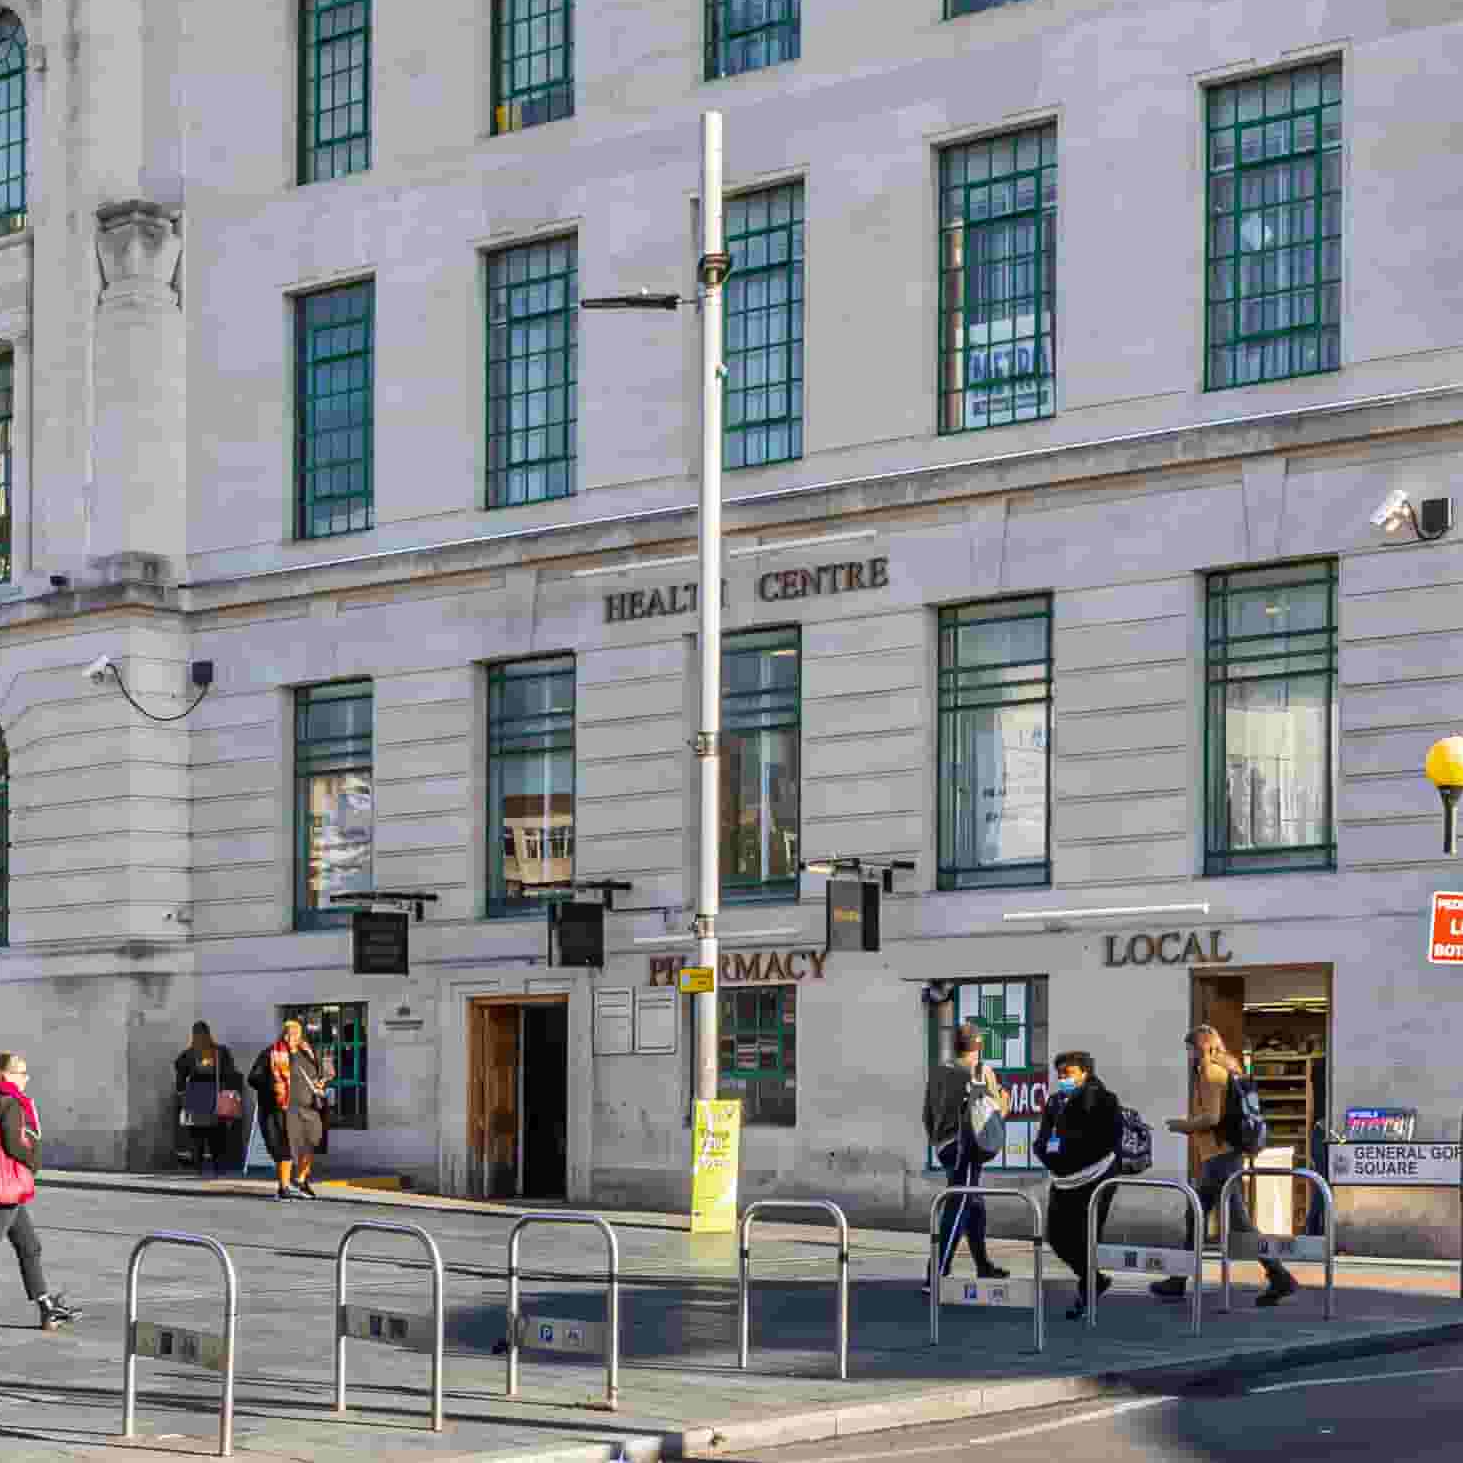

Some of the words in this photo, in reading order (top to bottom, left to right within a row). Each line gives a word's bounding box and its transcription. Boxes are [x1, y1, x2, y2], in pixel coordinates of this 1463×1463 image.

[759, 557, 889, 601] CENTRE
[1104, 930, 1233, 966] LOCAL
[1354, 1146, 1426, 1161] GENERAL
[1354, 1161, 1418, 1176] SQUARE
